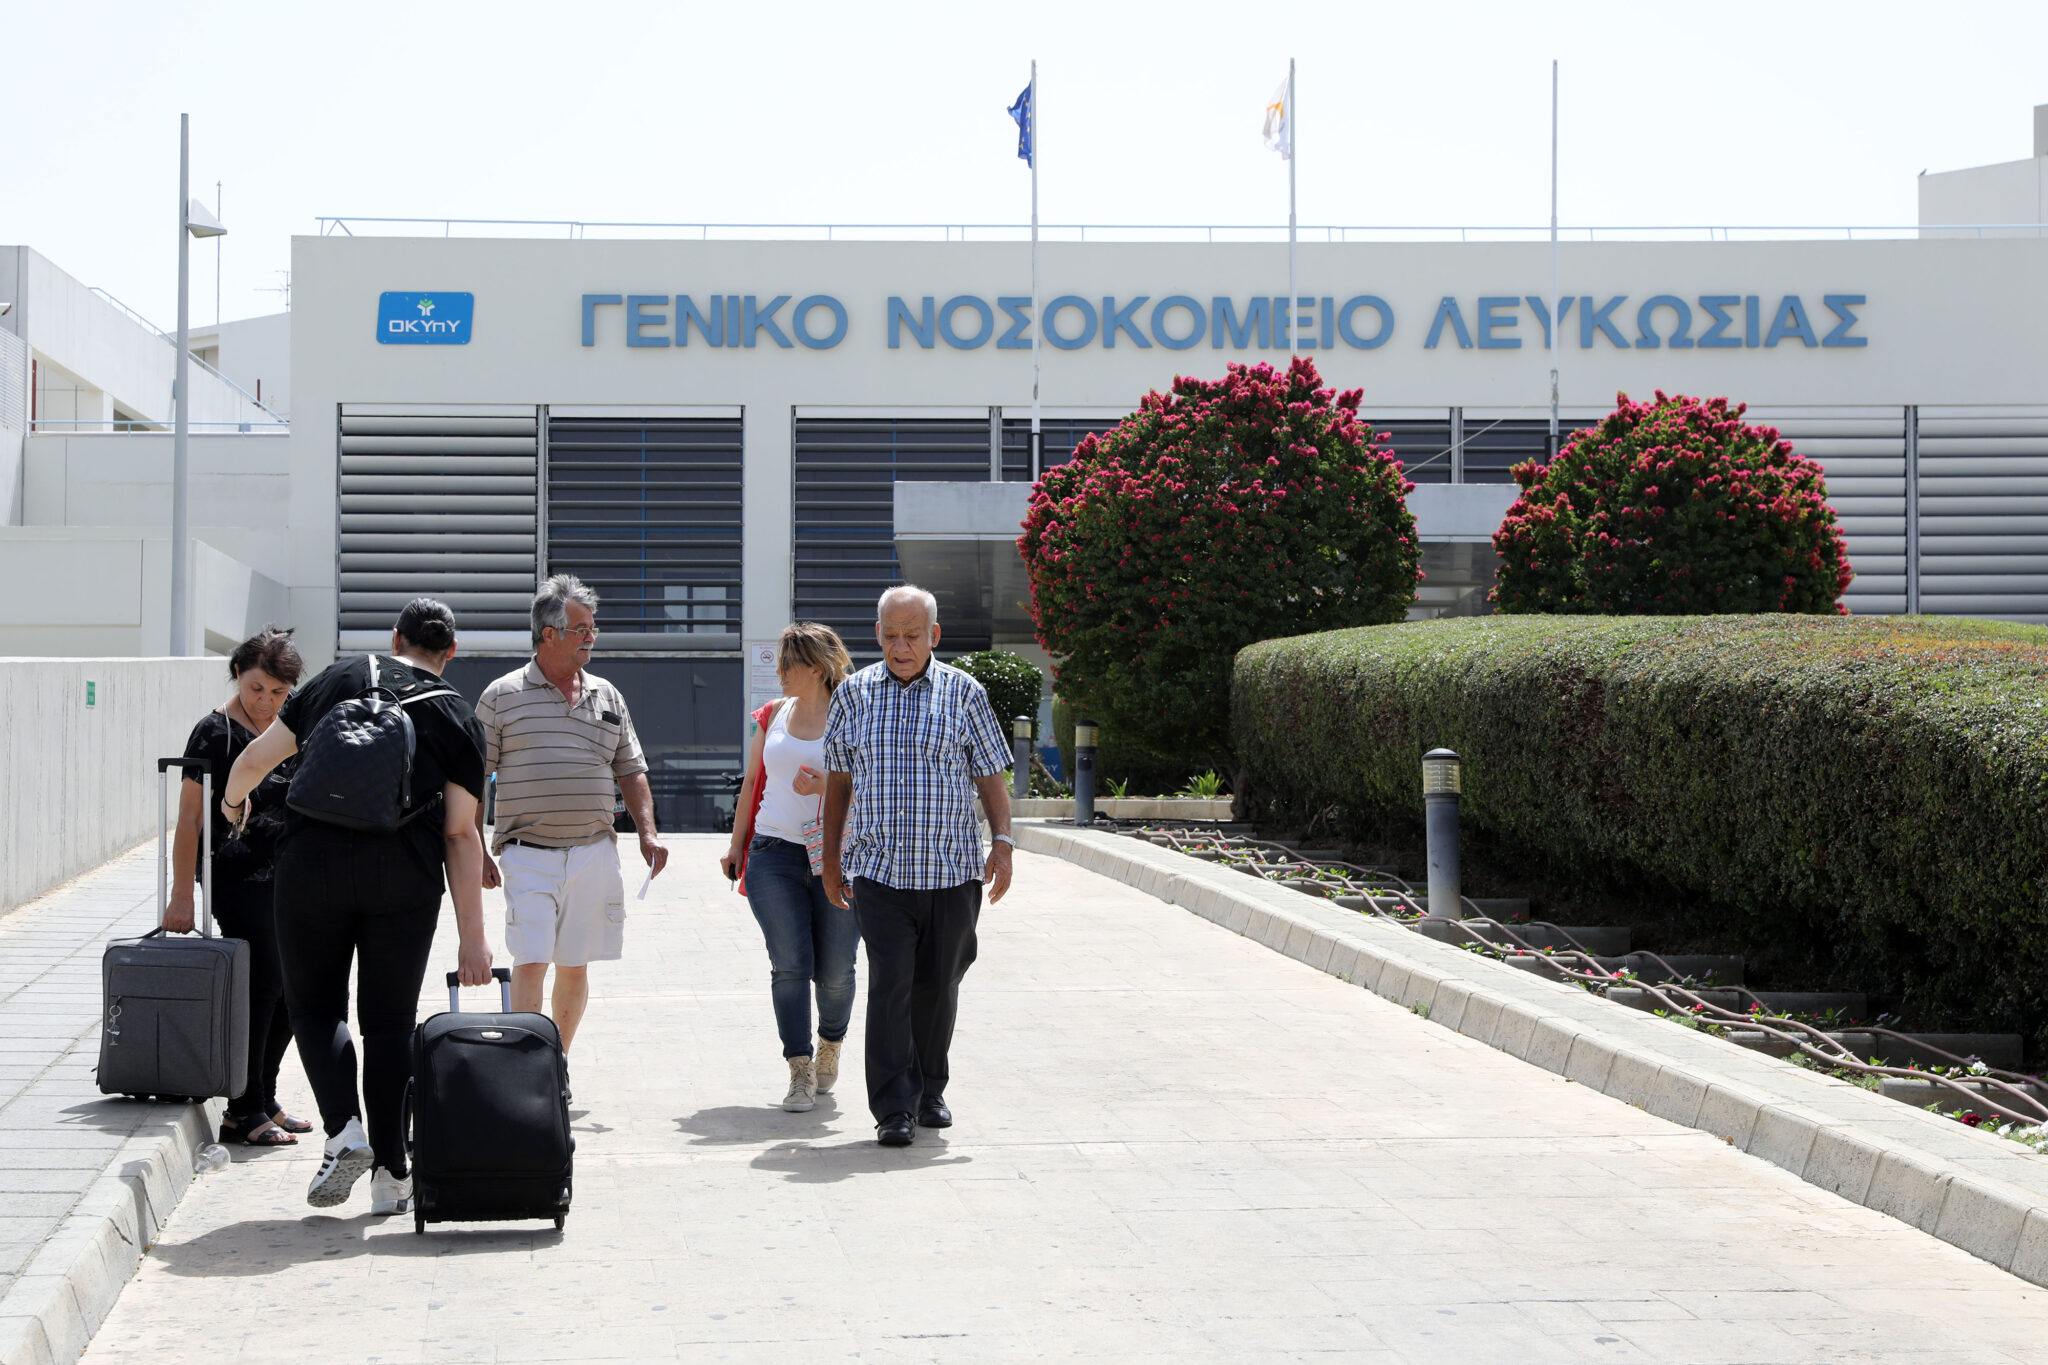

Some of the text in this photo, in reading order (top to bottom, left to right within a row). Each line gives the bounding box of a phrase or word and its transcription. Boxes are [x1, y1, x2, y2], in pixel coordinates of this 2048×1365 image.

[581, 294, 1869, 350] ΓΕΝΙΚΟ ΝΟΣΟΚΟΜΕΙΟ ΛΕΥΚΩΣΙΑΣ
